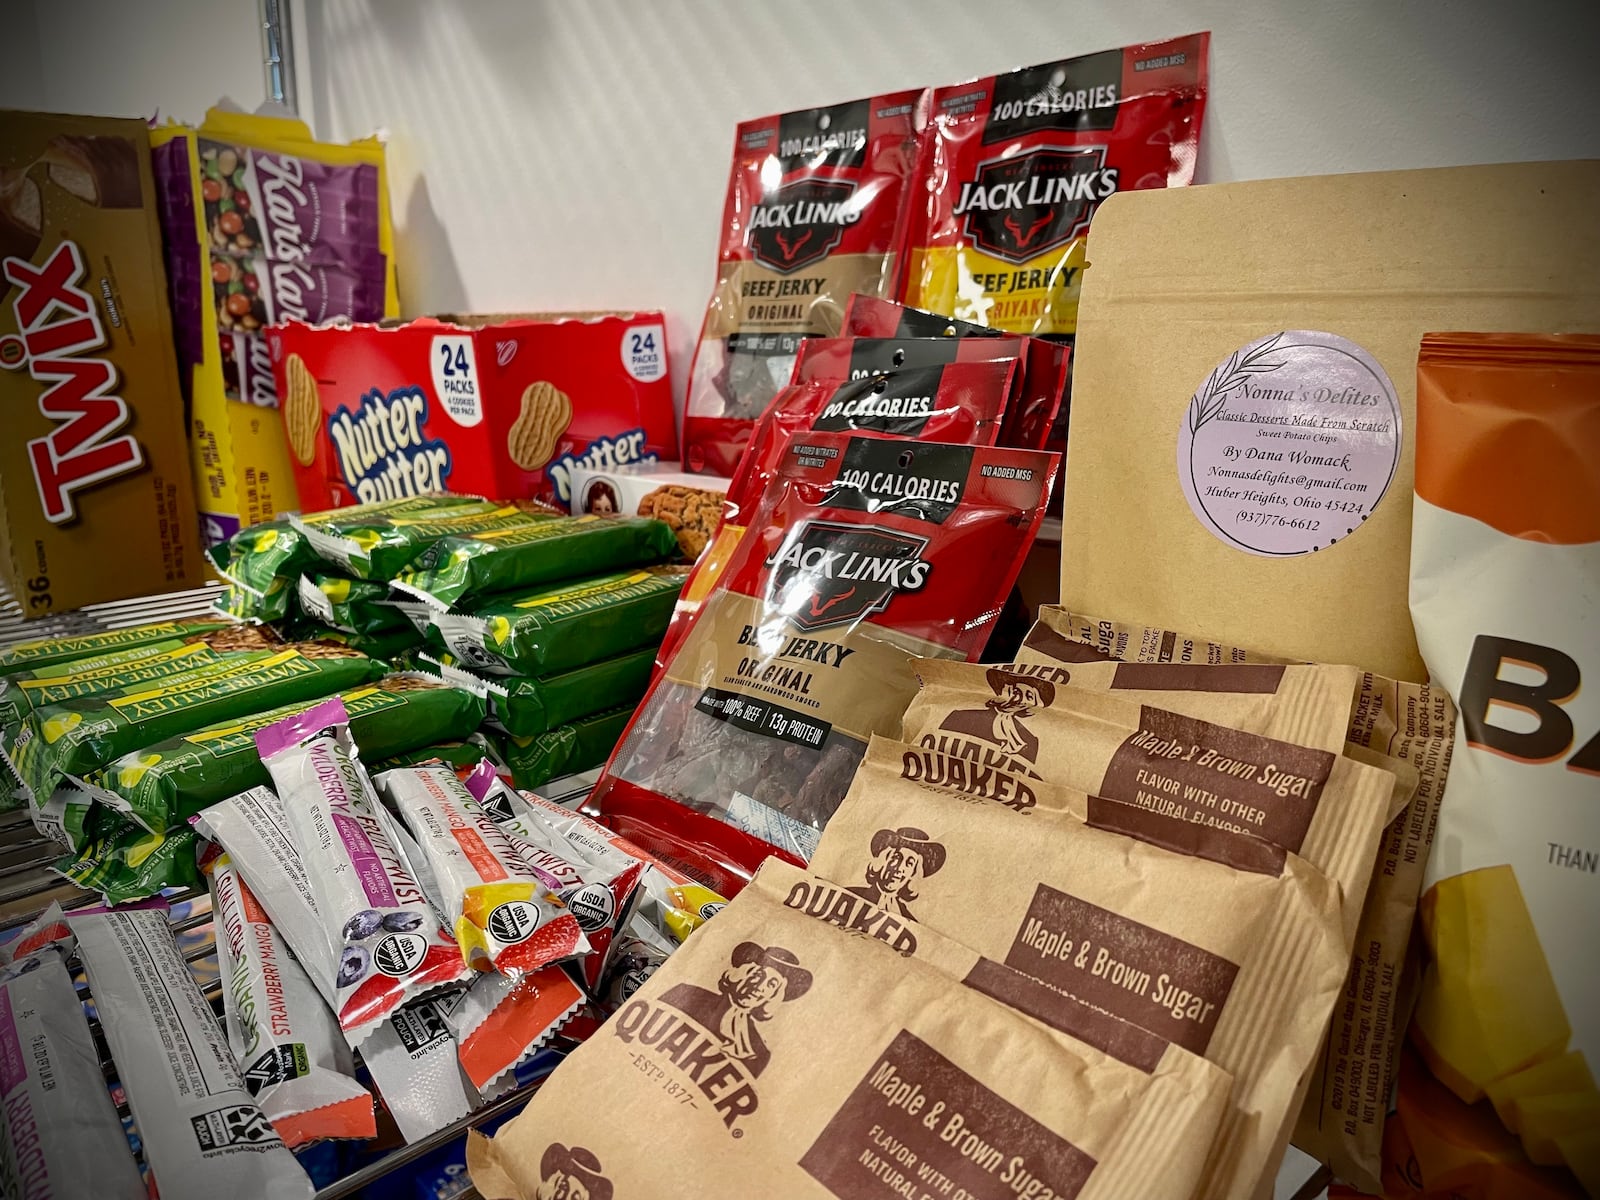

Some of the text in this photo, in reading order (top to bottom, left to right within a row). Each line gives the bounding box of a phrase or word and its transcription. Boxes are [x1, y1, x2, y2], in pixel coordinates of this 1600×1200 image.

[994, 102, 1023, 121] 100
[1026, 84, 1115, 116] CALORIES
[954, 168, 1117, 214] JACK LINK'S
[750, 204, 791, 229] JACK
[742, 278, 827, 298] BEEF JERKY
[748, 304, 803, 320] ORIGINAL
[632, 333, 655, 353] 24
[441, 344, 469, 377] 24
[444, 380, 474, 395] PACKS
[1236, 384, 1380, 407] Nonna's Delites
[842, 397, 930, 417] CALORIES
[1216, 409, 1390, 433] Classic Desserts Made From Scratch
[331, 394, 424, 487] Nutter
[1256, 429, 1338, 444] Sweet Potato Chips
[981, 465, 1032, 480] NO ADDED MSG
[1222, 445, 1352, 472] By Dana Womack
[843, 469, 960, 502] 100 CALORIES
[1207, 466, 1368, 493] Nonnasdelights@gmail.com
[1204, 486, 1364, 514] Huber Heights, Ohio 45424
[1235, 510, 1320, 532] (937)776-6612
[28, 540, 50, 609] 36 COUNT
[766, 542, 930, 589] JACK LINK'S
[12, 625, 178, 660] NATURE VALLEY
[780, 637, 855, 668] JERKY
[40, 652, 214, 706] NATURE VALLEY
[67, 659, 109, 675] HONEY
[69, 656, 173, 682] CRUNCHY
[160, 664, 264, 694] CRUNCHY
[221, 658, 309, 693] NATURE
[135, 684, 220, 718] VALLEY
[795, 696, 821, 709] SMOKED
[1357, 692, 1369, 727] PACKET
[1373, 693, 1383, 715] MILK.
[1435, 697, 1445, 721] SALE
[722, 698, 824, 746] 100% BEEF 13g PROTEIN
[1406, 695, 1417, 738] Company
[1425, 722, 1445, 773] INDIVIDUAL
[310, 743, 350, 813] WILDBERRY
[1131, 730, 1315, 800] Maple & Brown Sugar
[900, 751, 1037, 813] QUAKER
[1419, 772, 1433, 798] FOR
[1136, 769, 1179, 794] FLAVOR
[1183, 785, 1218, 809] WITH
[1220, 798, 1266, 826] OTHER
[1136, 790, 1188, 821] NATURAL
[441, 801, 465, 828] MANGO
[523, 792, 617, 839] STRAWBERRY MANGO
[1408, 799, 1429, 845] LABELED
[356, 815, 427, 905] FRUIT TWIST
[533, 849, 584, 886] TWIST
[1404, 846, 1416, 864] NOT
[1547, 842, 1600, 875] THAN
[363, 871, 379, 894] FLAVORS
[373, 872, 391, 901] ARTIFICIAL
[573, 903, 604, 922] ORGANIC
[582, 893, 605, 909] USDA
[499, 907, 517, 937] ORGANIC
[512, 905, 530, 928] USDA
[783, 879, 919, 958] QUAKER
[386, 940, 403, 970] ORGANIC
[400, 937, 417, 960] USDA
[254, 924, 291, 1036] STRAWBERRY MANGO
[1021, 916, 1215, 1025] Maple & Brown Sugar
[1383, 963, 1395, 988] SALE
[1374, 991, 1391, 1043] INDIVIDUAL
[394, 1018, 414, 1047] POUCH
[615, 999, 758, 1130] QUAKER
[1372, 1044, 1383, 1062] FOR
[1366, 1063, 1380, 1104] LABELED
[870, 1060, 925, 1117] Maple
[922, 1101, 946, 1130] &
[940, 1113, 1003, 1174] Brown
[1363, 1105, 1374, 1125] NOT
[859, 1148, 920, 1200] NATURAL
[869, 1124, 955, 1197] FLAVOR WITH
